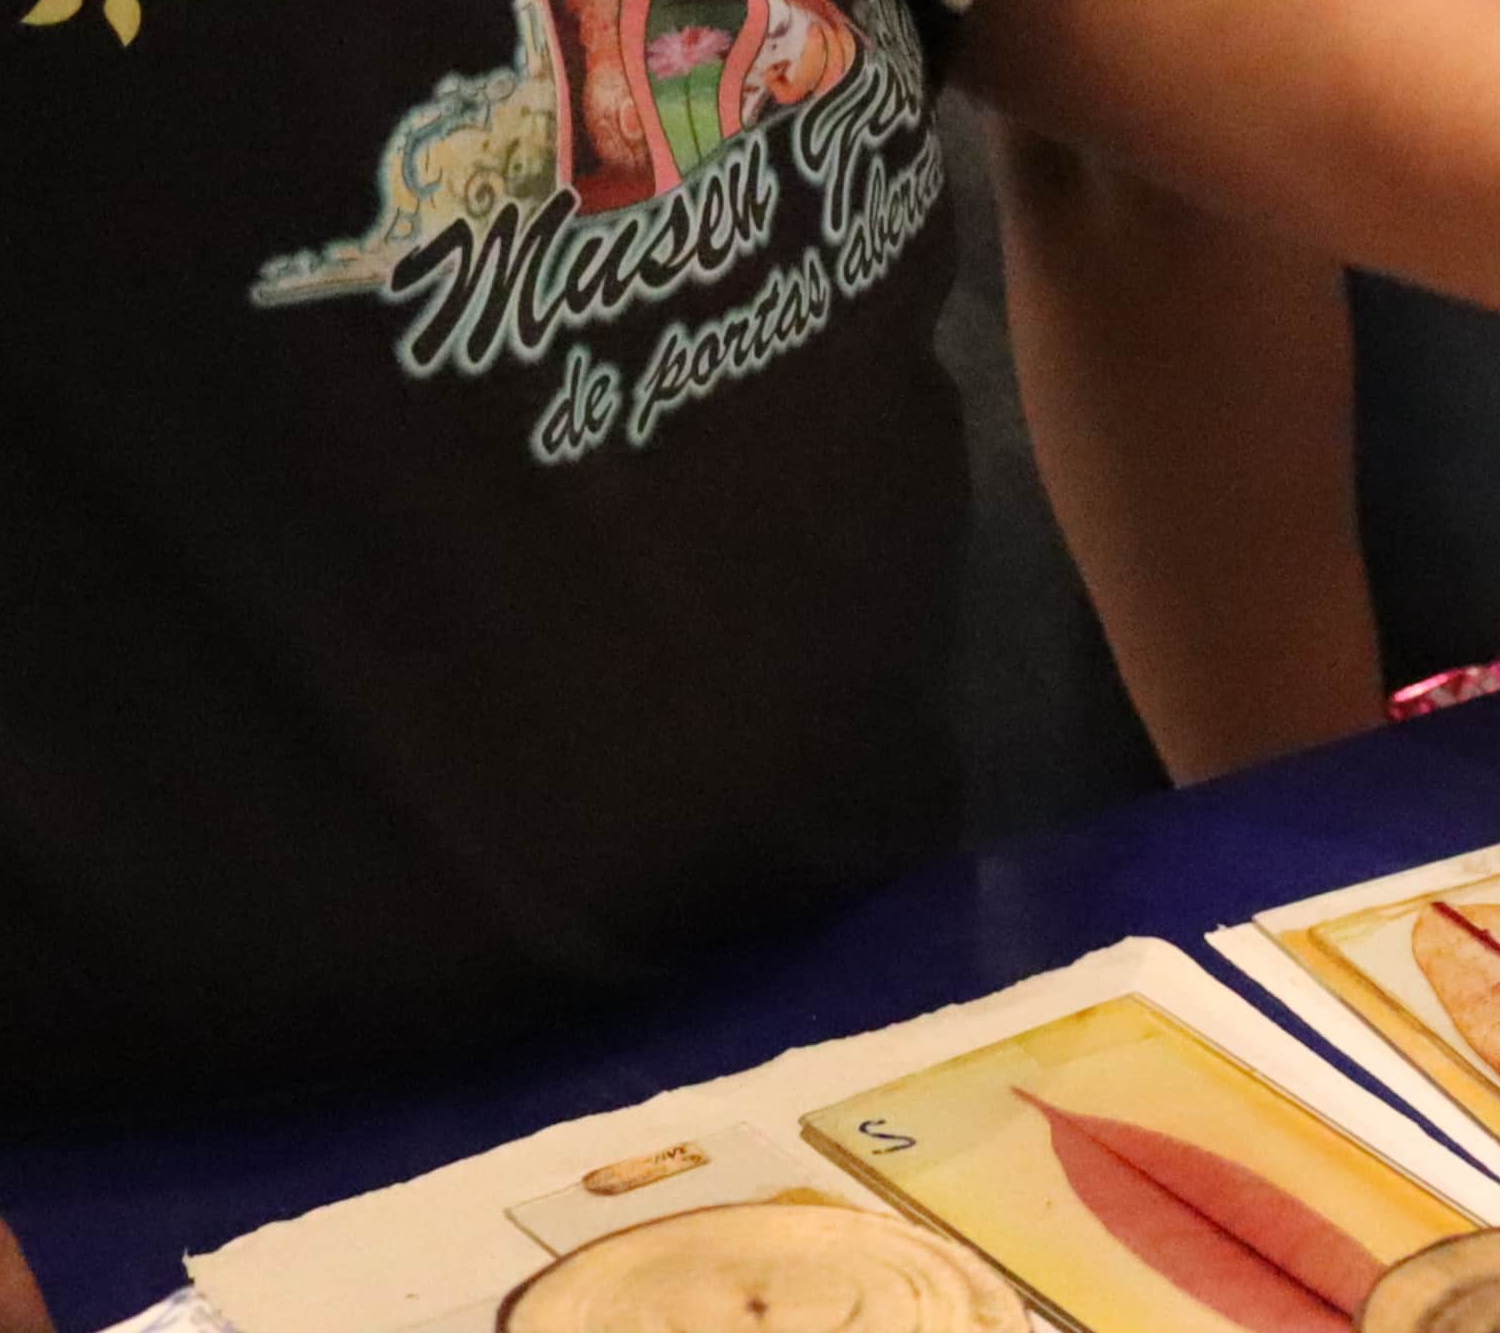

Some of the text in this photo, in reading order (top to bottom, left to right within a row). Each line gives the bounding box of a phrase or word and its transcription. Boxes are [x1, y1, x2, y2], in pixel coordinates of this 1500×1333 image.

[388, 131, 778, 371] Museu
[534, 343, 622, 463] de
[630, 247, 830, 445] portas
